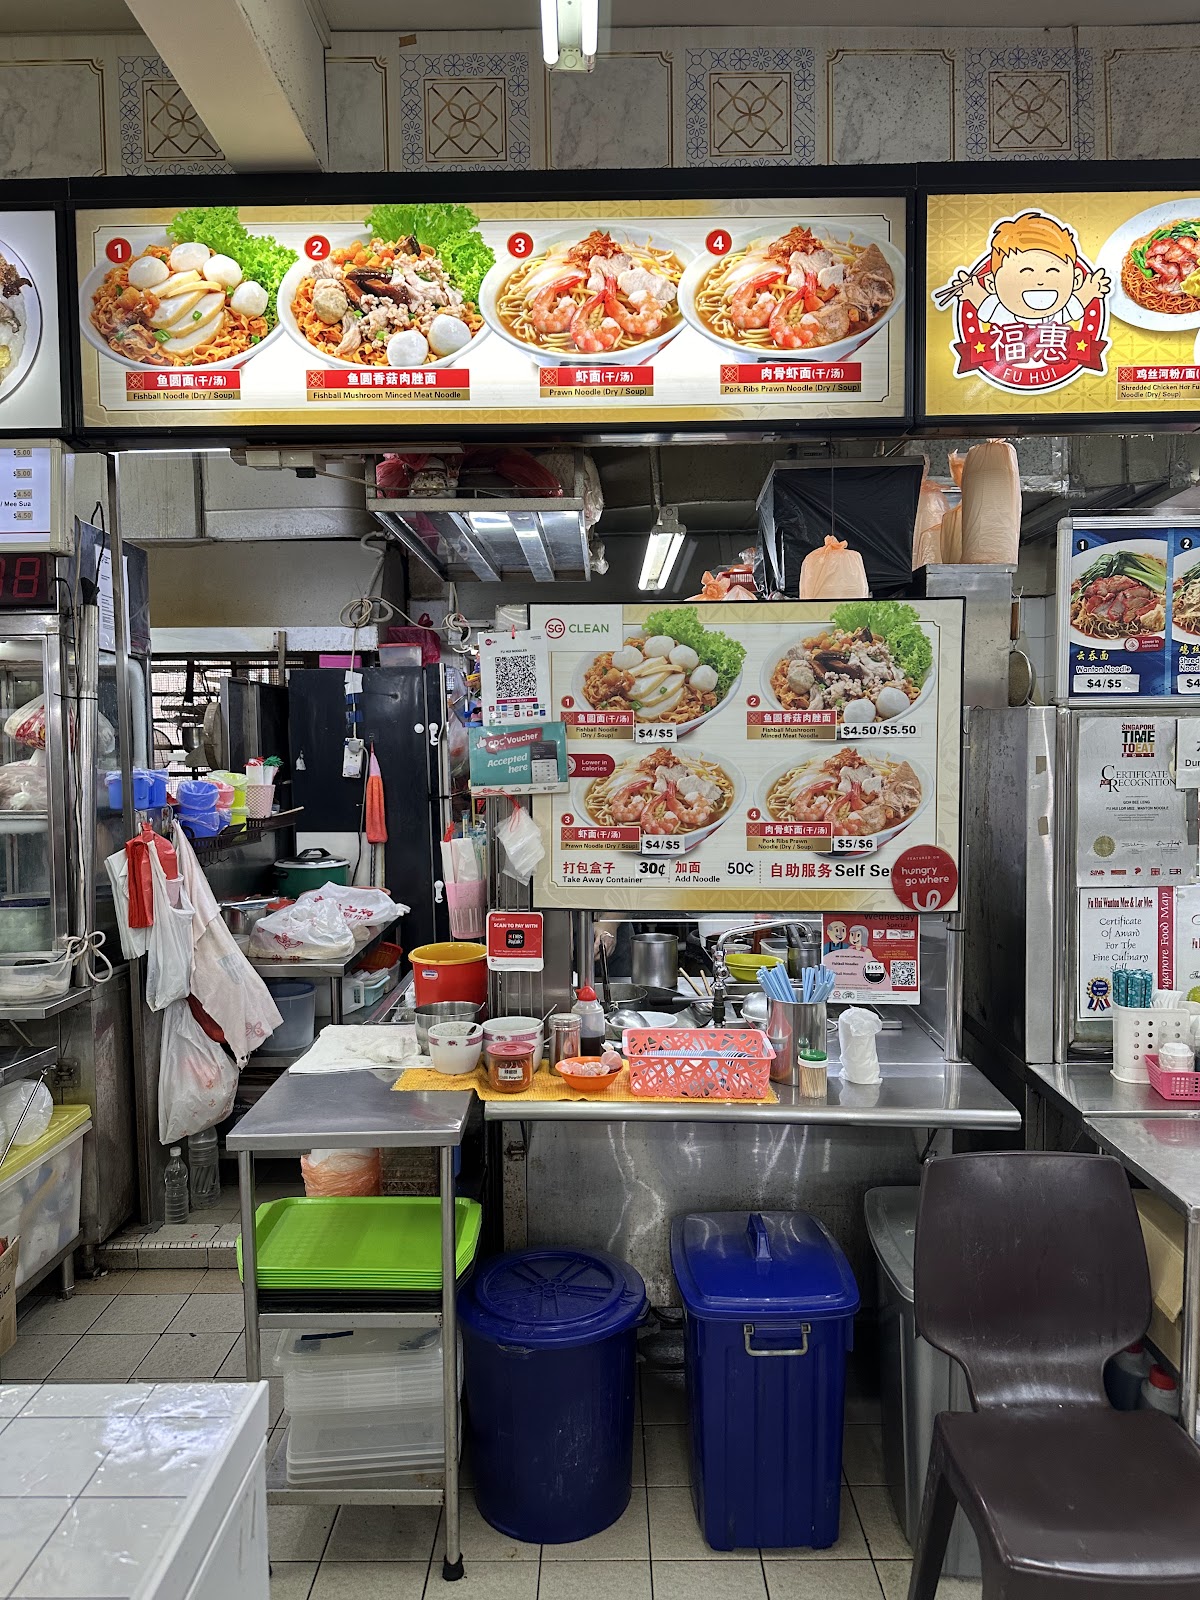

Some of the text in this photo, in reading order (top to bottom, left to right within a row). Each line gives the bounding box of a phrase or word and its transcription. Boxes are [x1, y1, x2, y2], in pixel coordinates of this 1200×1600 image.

[114, 240, 122, 258] 1
[310, 239, 323, 257] 2
[515, 237, 527, 254] 3
[712, 235, 725, 252] 4
[989, 323, 1071, 362] 福惠
[575, 369, 634, 384] 虾面(干/汤)
[760, 365, 845, 381] 肉骨虾面(干/汤)
[1002, 367, 1058, 383] FU HUI
[156, 374, 227, 388] 鱼圆面(干/汤)
[548, 388, 573, 397] Prawn
[573, 387, 601, 397] Noodle
[602, 387, 619, 397] (Dry
[625, 387, 648, 397] Soup)
[724, 384, 742, 393] Pork
[742, 383, 760, 393] Ribs
[760, 383, 785, 393] Prawn
[785, 383, 814, 393] Noodle
[815, 382, 832, 393] (Dry
[837, 382, 861, 393] Soup)
[133, 391, 161, 401] Fishball
[161, 391, 190, 401] Noodle
[190, 391, 208, 401] (Dry
[212, 391, 236, 401] Soup)
[313, 390, 462, 400] Fishball Mushroom Minced Meat Noodle
[1120, 391, 1144, 399] Noodle
[1161, 391, 1182, 400] Soup)
[1079, 541, 1086, 550] 1
[1183, 539, 1190, 548] 2
[547, 623, 610, 633] SG CLEAN
[1076, 650, 1109, 661] 云吞面
[1076, 665, 1132, 674] Wanton Noodle
[1086, 679, 1122, 689] $4/$5
[750, 697, 757, 705] 2
[843, 725, 917, 736] $4.50/$5.50
[1121, 723, 1156, 731] SINGAPORE
[506, 732, 539, 745] Voucher
[638, 729, 673, 738] $4/$5
[1121, 730, 1156, 743] TIME
[487, 752, 528, 768] Accepted
[508, 763, 529, 774] here
[1101, 764, 1168, 782] CERTIFICATE
[564, 816, 571, 824] 3
[750, 810, 757, 819] 4
[645, 840, 680, 850] $4/$5
[837, 839, 873, 849] $5/$6
[562, 861, 616, 875] 打包盒子
[639, 861, 666, 877] 30¢
[675, 861, 701, 874] 加面
[727, 862, 754, 875] 50¢
[770, 863, 833, 878] 自助服务
[834, 864, 893, 878] Self Se
[901, 866, 938, 877] hungry
[562, 876, 643, 884] Take Away Container
[675, 875, 721, 883] Add Noodle
[905, 874, 950, 887] go where
[1120, 896, 1130, 908] Mee
[1159, 891, 1172, 919] Map
[1099, 914, 1142, 927] Certificate
[1101, 926, 1141, 940] Of Award
[1160, 922, 1170, 947] Food
[1105, 938, 1137, 951] For The
[1092, 951, 1149, 963] Fine Culinary
